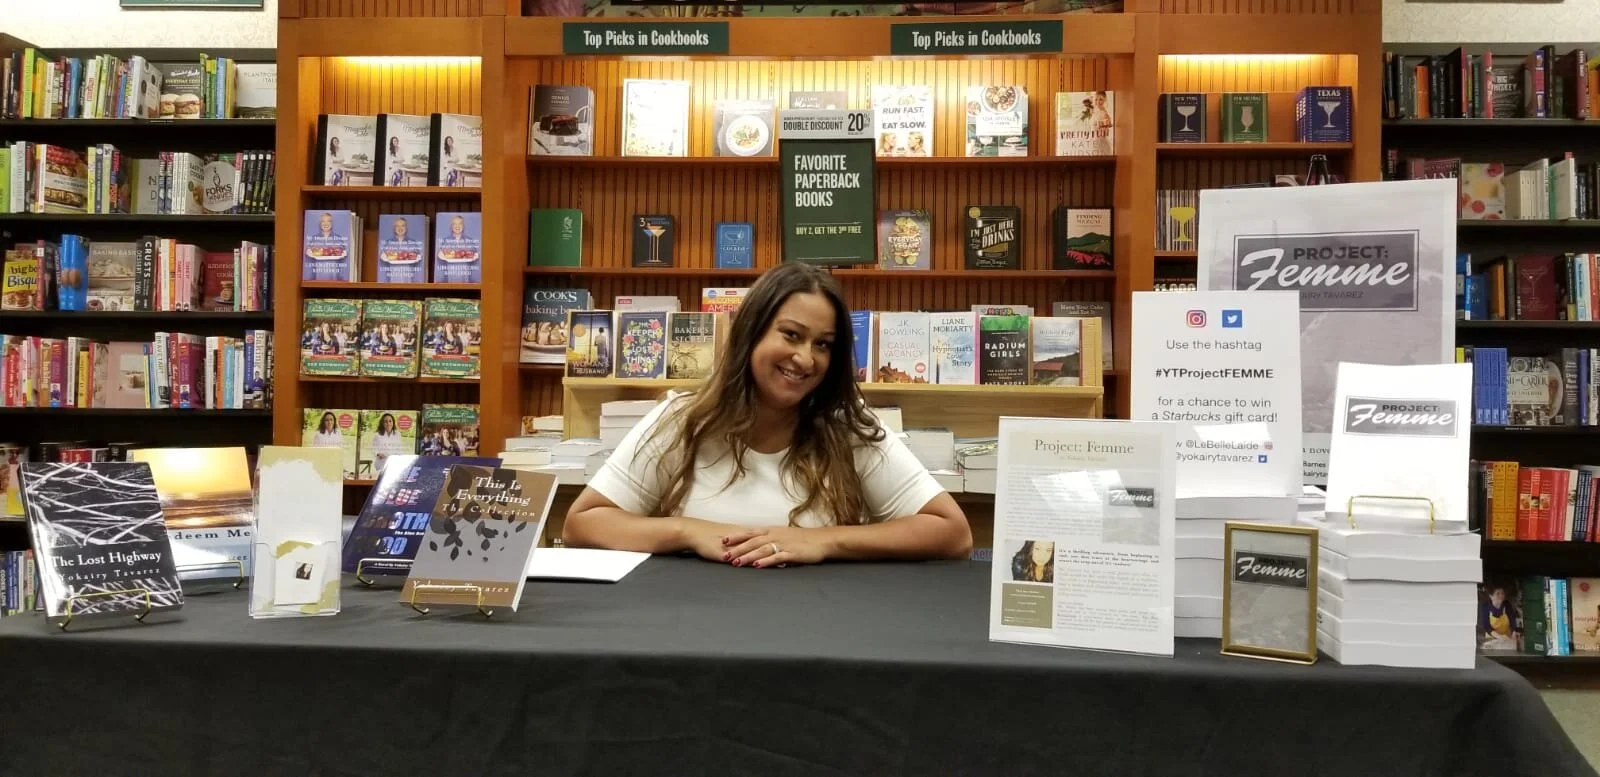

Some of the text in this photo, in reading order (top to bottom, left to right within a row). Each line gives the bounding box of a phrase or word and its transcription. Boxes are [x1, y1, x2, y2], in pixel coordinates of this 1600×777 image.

[583, 30, 709, 48] Top Picks in Cookbooks
[912, 29, 1041, 49] Top Picks in Cookbooks
[1317, 89, 1341, 97] TEXAS
[902, 106, 925, 114] FAST.
[783, 121, 843, 131] DOUBLE DISCOUNT
[882, 121, 927, 130] EAT SLOW.
[1071, 140, 1097, 149] KATE
[794, 154, 847, 171] FAVORITE
[794, 172, 861, 189] PAPERBACK
[795, 191, 834, 208] BOOKS
[795, 226, 808, 236] BUY
[814, 226, 826, 235] GET
[826, 225, 838, 235] THE
[847, 225, 862, 234] FREE
[983, 224, 997, 236] JUST
[998, 219, 1014, 230] HERE
[981, 228, 1015, 248] DRINKS
[1292, 245, 1389, 260] PROJECT:
[144, 241, 153, 278] CRUSTS
[10, 264, 38, 275] big bo
[1240, 248, 1410, 291] Femme
[7, 275, 38, 290] Bisqu
[533, 290, 578, 303] COOK'S
[525, 304, 559, 316] baking
[884, 328, 925, 336] ROWLING
[632, 345, 650, 353] LOST
[984, 342, 1026, 350] RADIUM
[1166, 340, 1262, 351] Use the hashtag
[884, 350, 924, 358] VACANCY
[989, 350, 1021, 358] GIRLS
[951, 359, 973, 367] Story
[1155, 368, 1273, 380] #YTProjectFEMME
[1157, 396, 1173, 406] for
[1188, 397, 1231, 407] chance
[1235, 398, 1247, 407] to
[1250, 398, 1271, 408] win
[1381, 404, 1440, 412] PROJECT:
[1151, 411, 1278, 424] a Starbucks gift card!
[1350, 403, 1454, 427] Femme
[1034, 439, 1134, 455] Project: Femme
[475, 476, 522, 490] This Is
[455, 488, 531, 506] Everything
[1110, 489, 1153, 503] Femme
[442, 503, 536, 517] The Collection
[174, 529, 250, 541] deem Me
[51, 551, 162, 568] The Lost Highway
[1236, 555, 1307, 580] Femme
[59, 568, 161, 584] Yokairy Tavarez
[464, 582, 510, 593] Taarez
